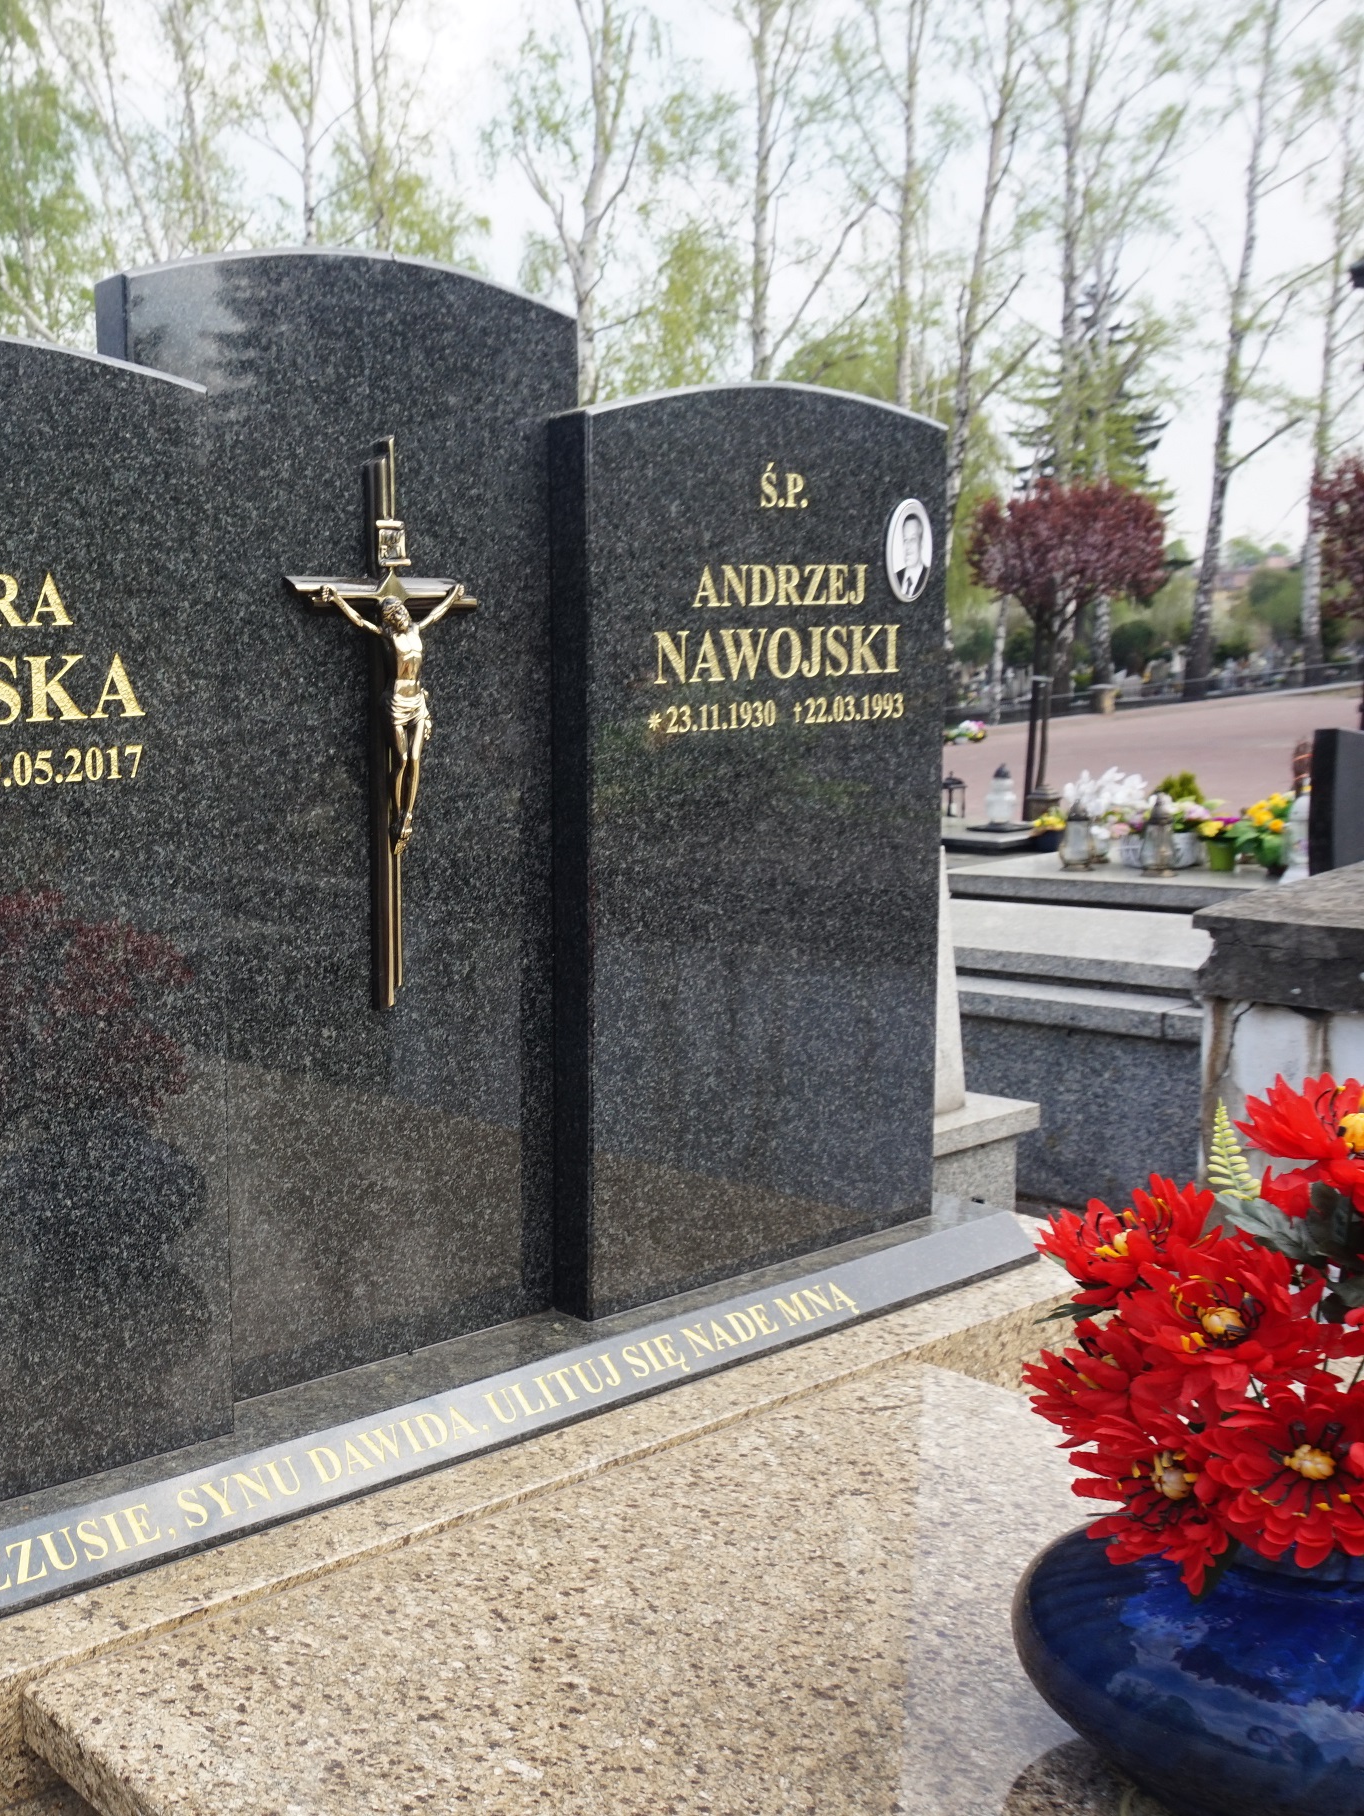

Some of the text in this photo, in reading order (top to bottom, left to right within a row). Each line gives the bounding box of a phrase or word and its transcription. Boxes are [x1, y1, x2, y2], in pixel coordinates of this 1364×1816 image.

[760, 462, 808, 508] Ś.P.
[692, 564, 868, 608] ANDRZEJ
[653, 624, 901, 685] NAWOJSKI
[176, 1455, 303, 1530] SYNU
[304, 1406, 490, 1485] DAWIDA,
[483, 1354, 623, 1425] ULITUJ
[622, 1334, 691, 1379] SIĘ
[678, 1304, 778, 1358] NADE
[773, 1281, 859, 1328] MNĄ
